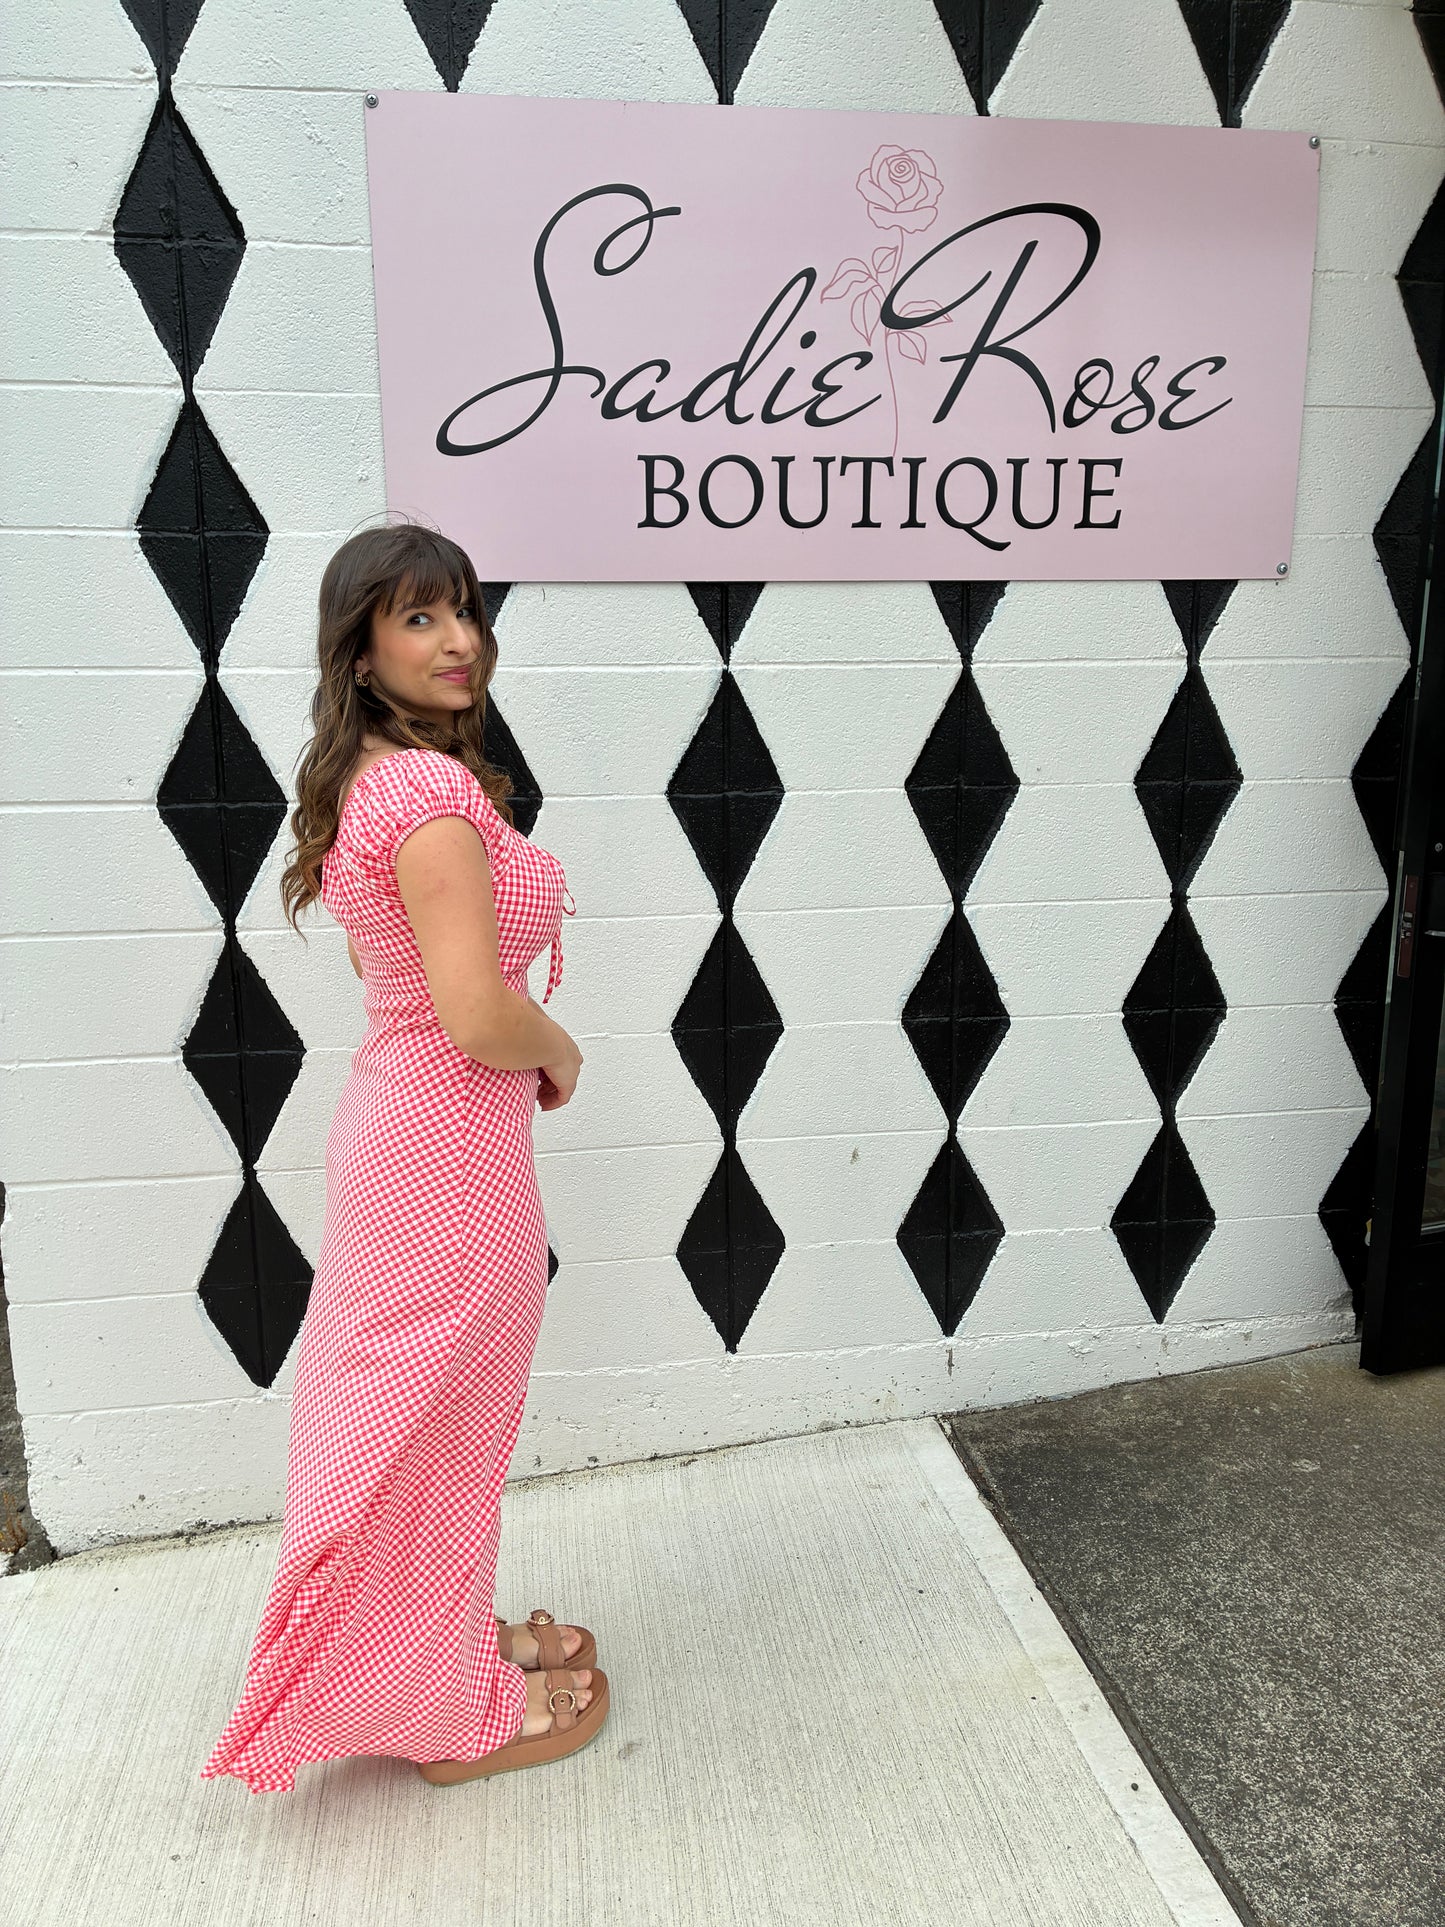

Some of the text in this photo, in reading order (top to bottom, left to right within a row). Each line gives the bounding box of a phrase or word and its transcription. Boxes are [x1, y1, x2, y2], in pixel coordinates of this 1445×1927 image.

[436, 183, 1233, 457] Sadie Rose
[637, 454, 1124, 552] BOUTIQUE
